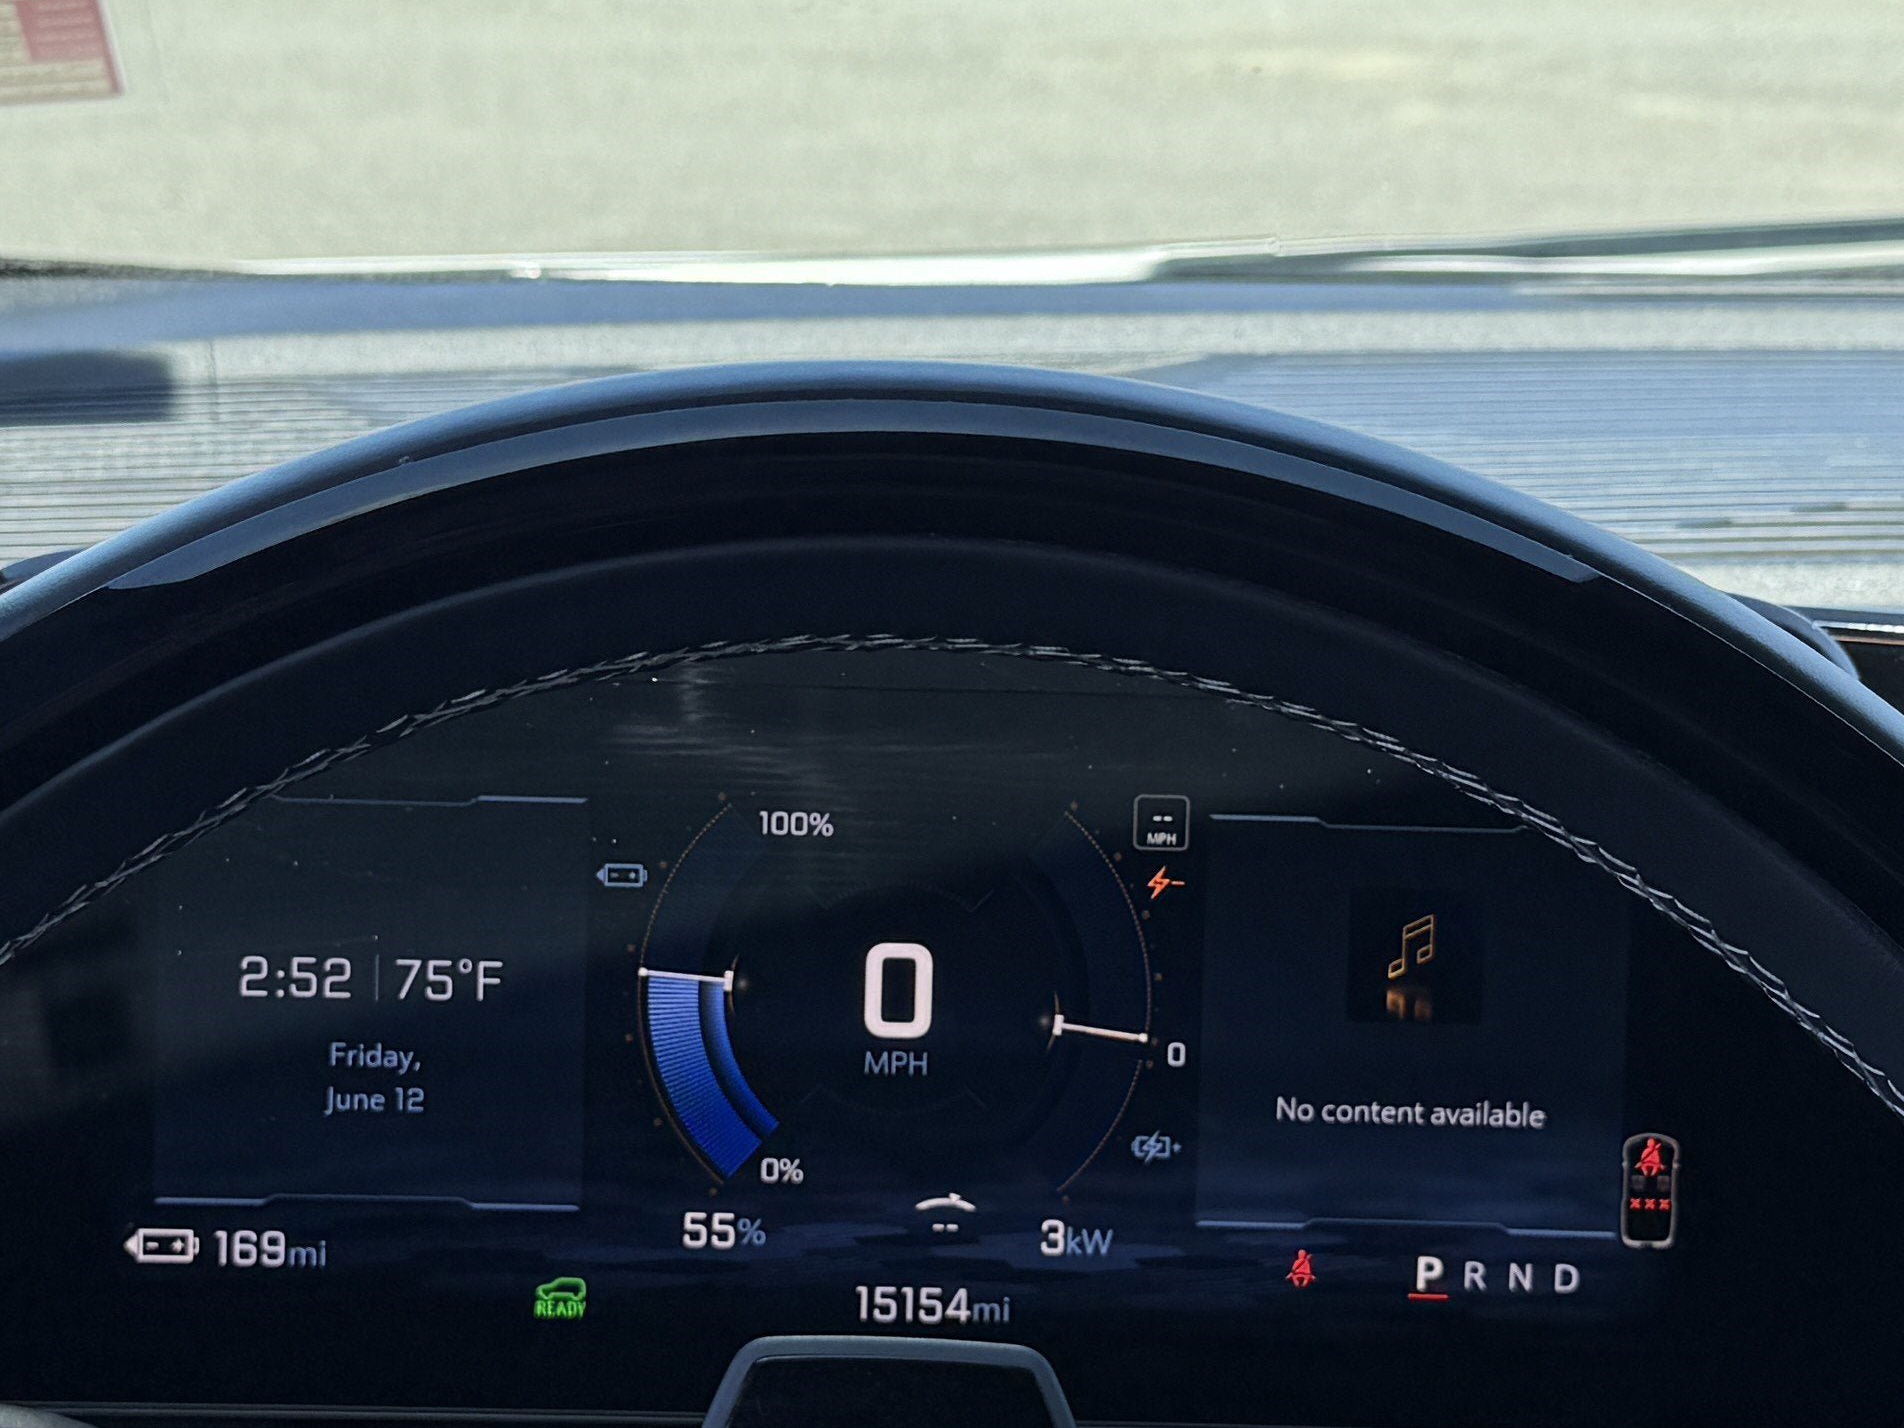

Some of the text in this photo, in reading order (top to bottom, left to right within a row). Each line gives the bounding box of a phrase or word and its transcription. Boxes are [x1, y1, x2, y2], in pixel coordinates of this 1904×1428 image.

[757, 810, 834, 838] 100%
[1146, 832, 1177, 847] MPH
[239, 956, 503, 1001] 2:52 75°F
[863, 942, 934, 1040] 0
[329, 1042, 422, 1073] Friday,
[863, 1052, 928, 1076] MPH
[1167, 1041, 1186, 1068] 0
[324, 1087, 425, 1116] June 12
[1276, 1095, 1546, 1130] No content available
[760, 1157, 804, 1184] 0%
[1416, 1256, 1580, 1292] P R N D
[534, 1299, 586, 1319] READY
